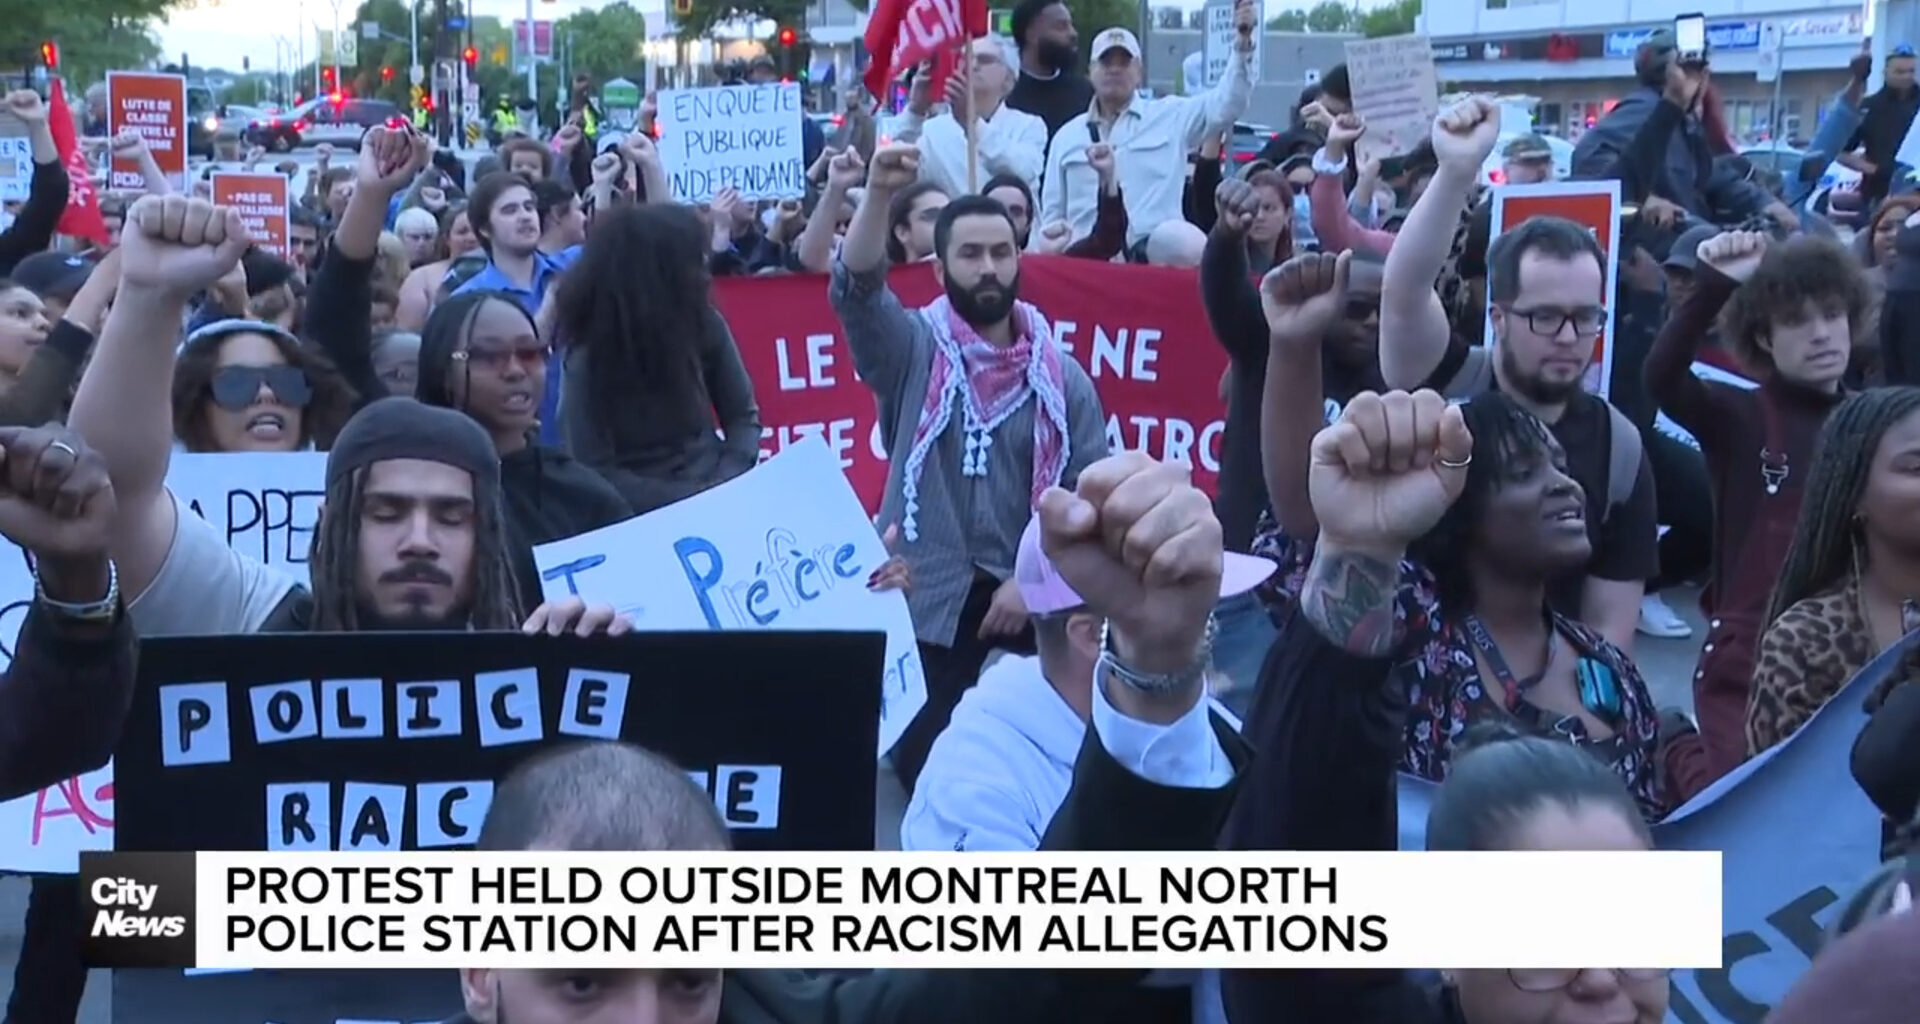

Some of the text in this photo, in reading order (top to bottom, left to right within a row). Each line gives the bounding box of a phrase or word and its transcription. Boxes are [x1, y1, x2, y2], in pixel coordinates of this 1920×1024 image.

[122, 98, 172, 111] LUTTE DE
[126, 112, 168, 124] CLASSE
[164, 127, 176, 137] LE
[685, 125, 787, 159] PUBLIQUE
[776, 333, 836, 391] LE
[1091, 324, 1162, 382] NE
[673, 527, 862, 631] Préfère
[178, 678, 609, 753] POLICE
